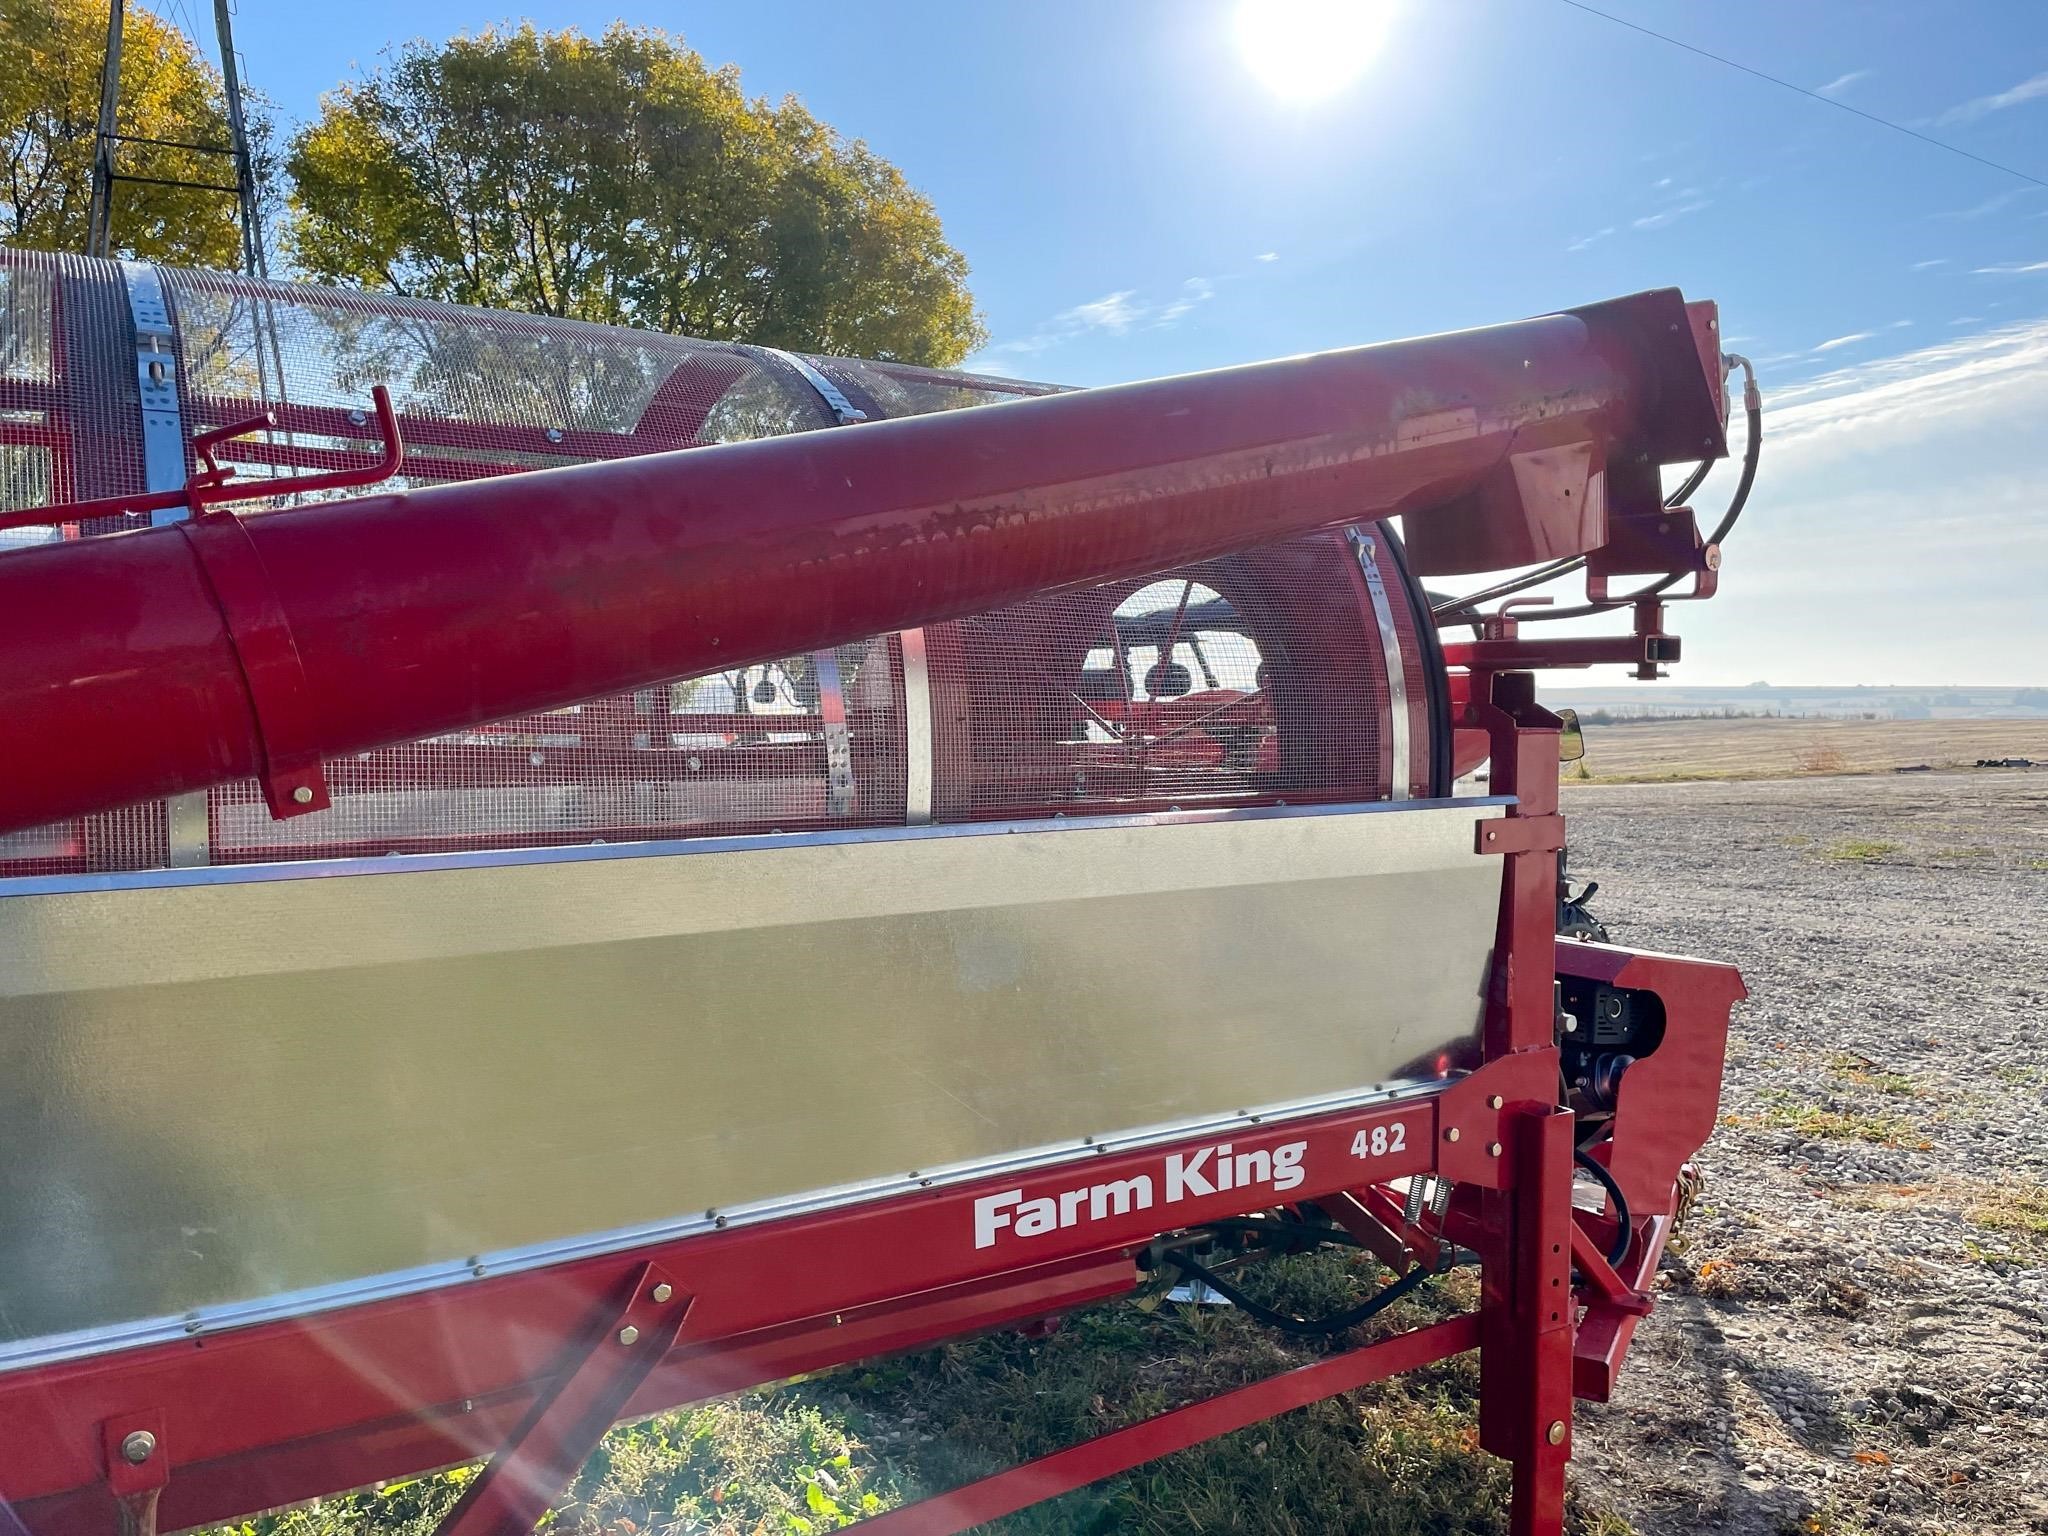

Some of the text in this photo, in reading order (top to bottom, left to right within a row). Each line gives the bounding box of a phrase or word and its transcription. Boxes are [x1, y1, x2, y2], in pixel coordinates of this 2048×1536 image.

[1350, 1122, 1406, 1160] 482
[974, 1140, 1307, 1250] Farm King
